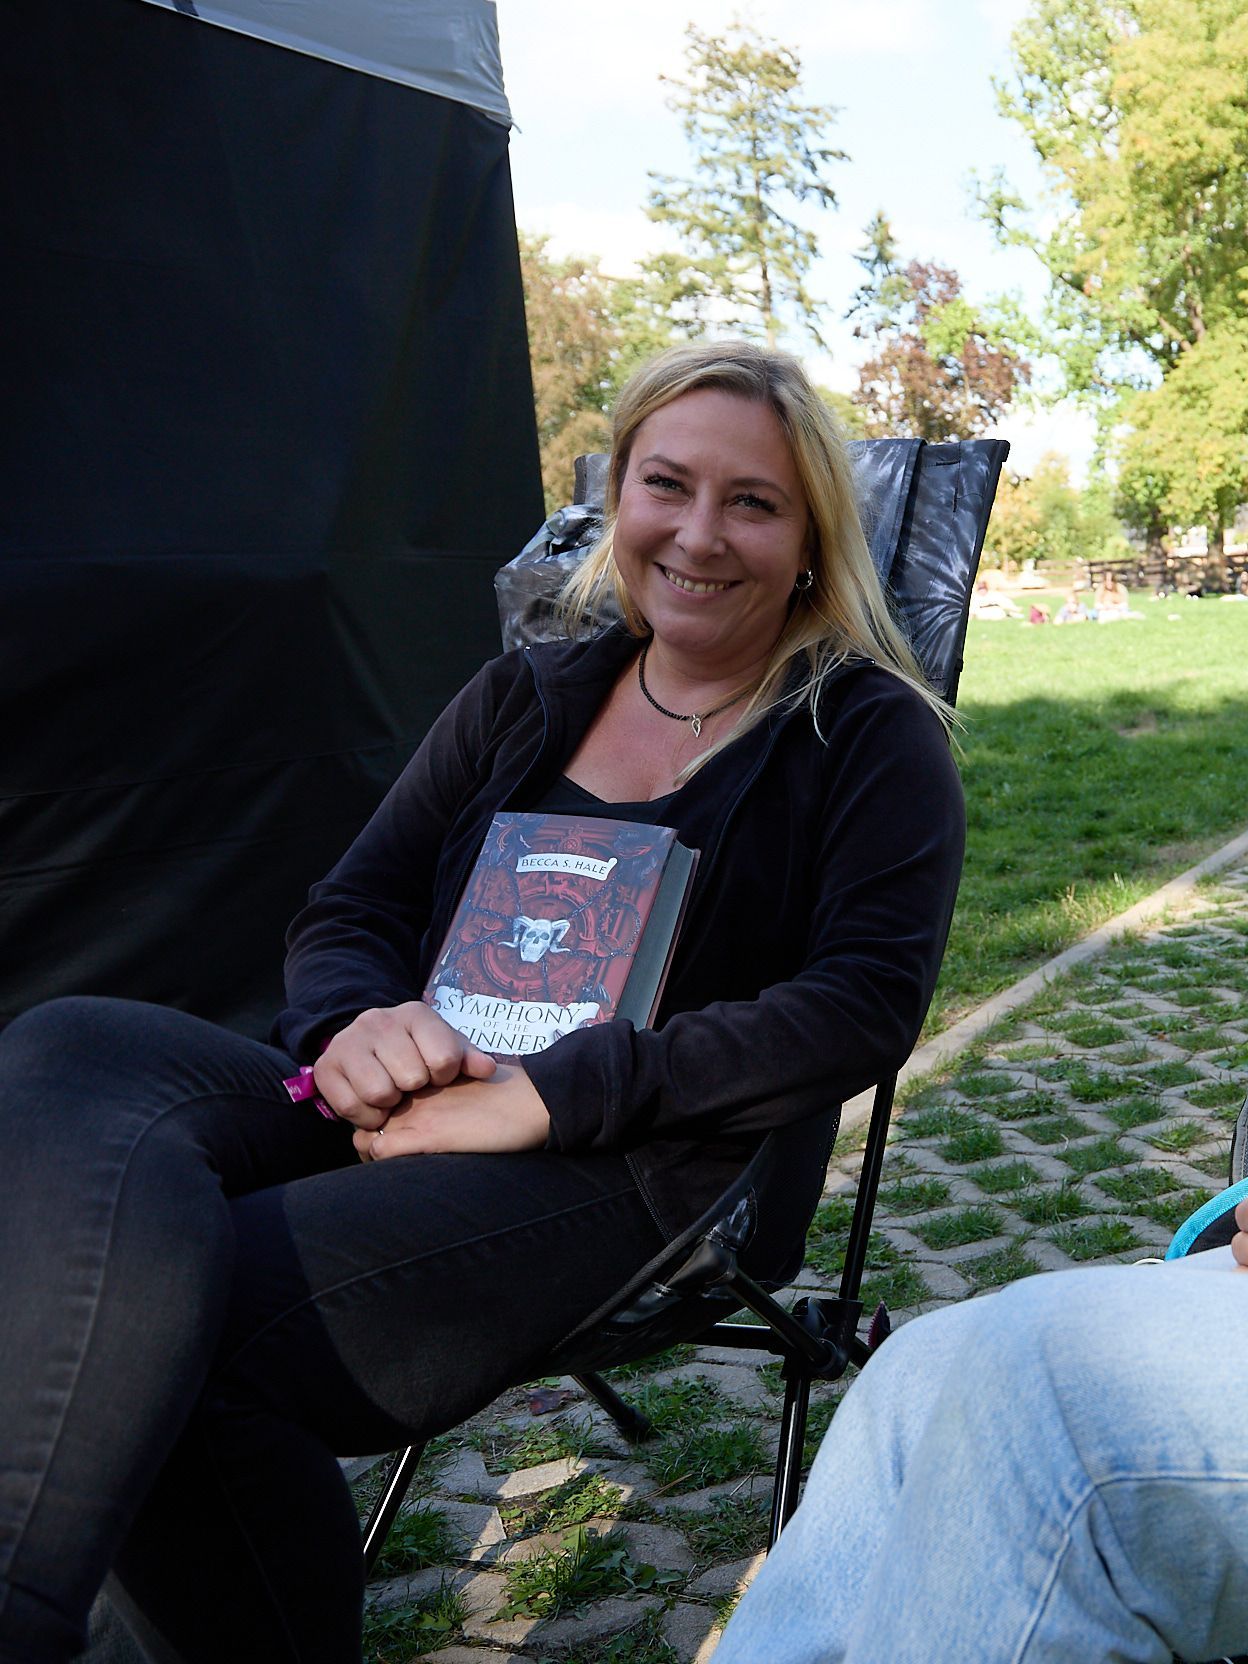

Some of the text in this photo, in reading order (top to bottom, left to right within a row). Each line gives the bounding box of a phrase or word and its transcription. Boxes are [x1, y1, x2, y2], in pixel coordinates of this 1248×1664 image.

[522, 858, 607, 875] BECCA S. HALE
[443, 993, 580, 1024] SYMPHONY
[483, 1020, 529, 1032] OF THE
